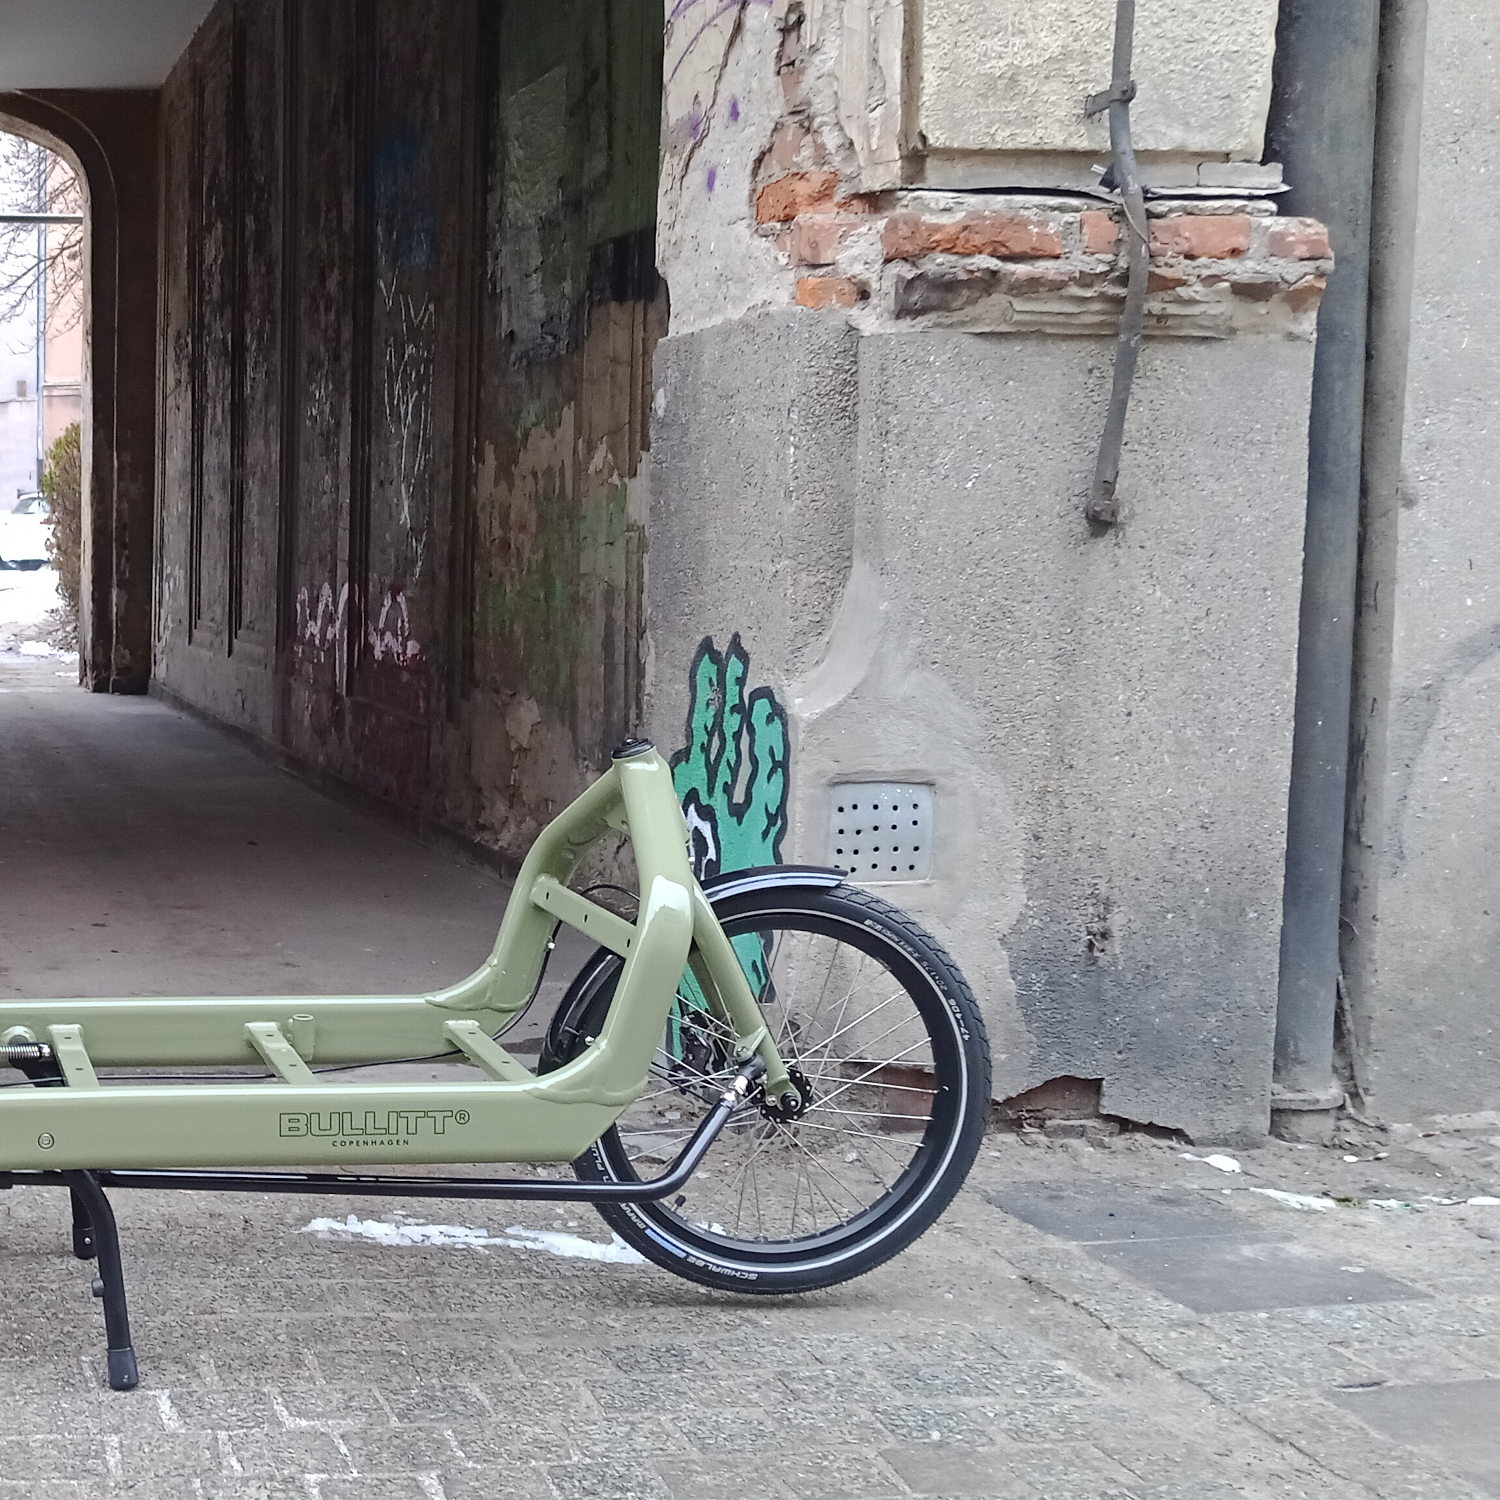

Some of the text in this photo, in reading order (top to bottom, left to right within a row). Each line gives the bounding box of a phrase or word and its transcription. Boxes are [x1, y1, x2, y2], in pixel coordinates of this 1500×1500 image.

[949, 998, 971, 1041] 47-406
[331, 1139, 409, 1148] COPENHAGEN
[602, 1175, 647, 1230] MARAN
[687, 1255, 759, 1281] SCHWALBE
